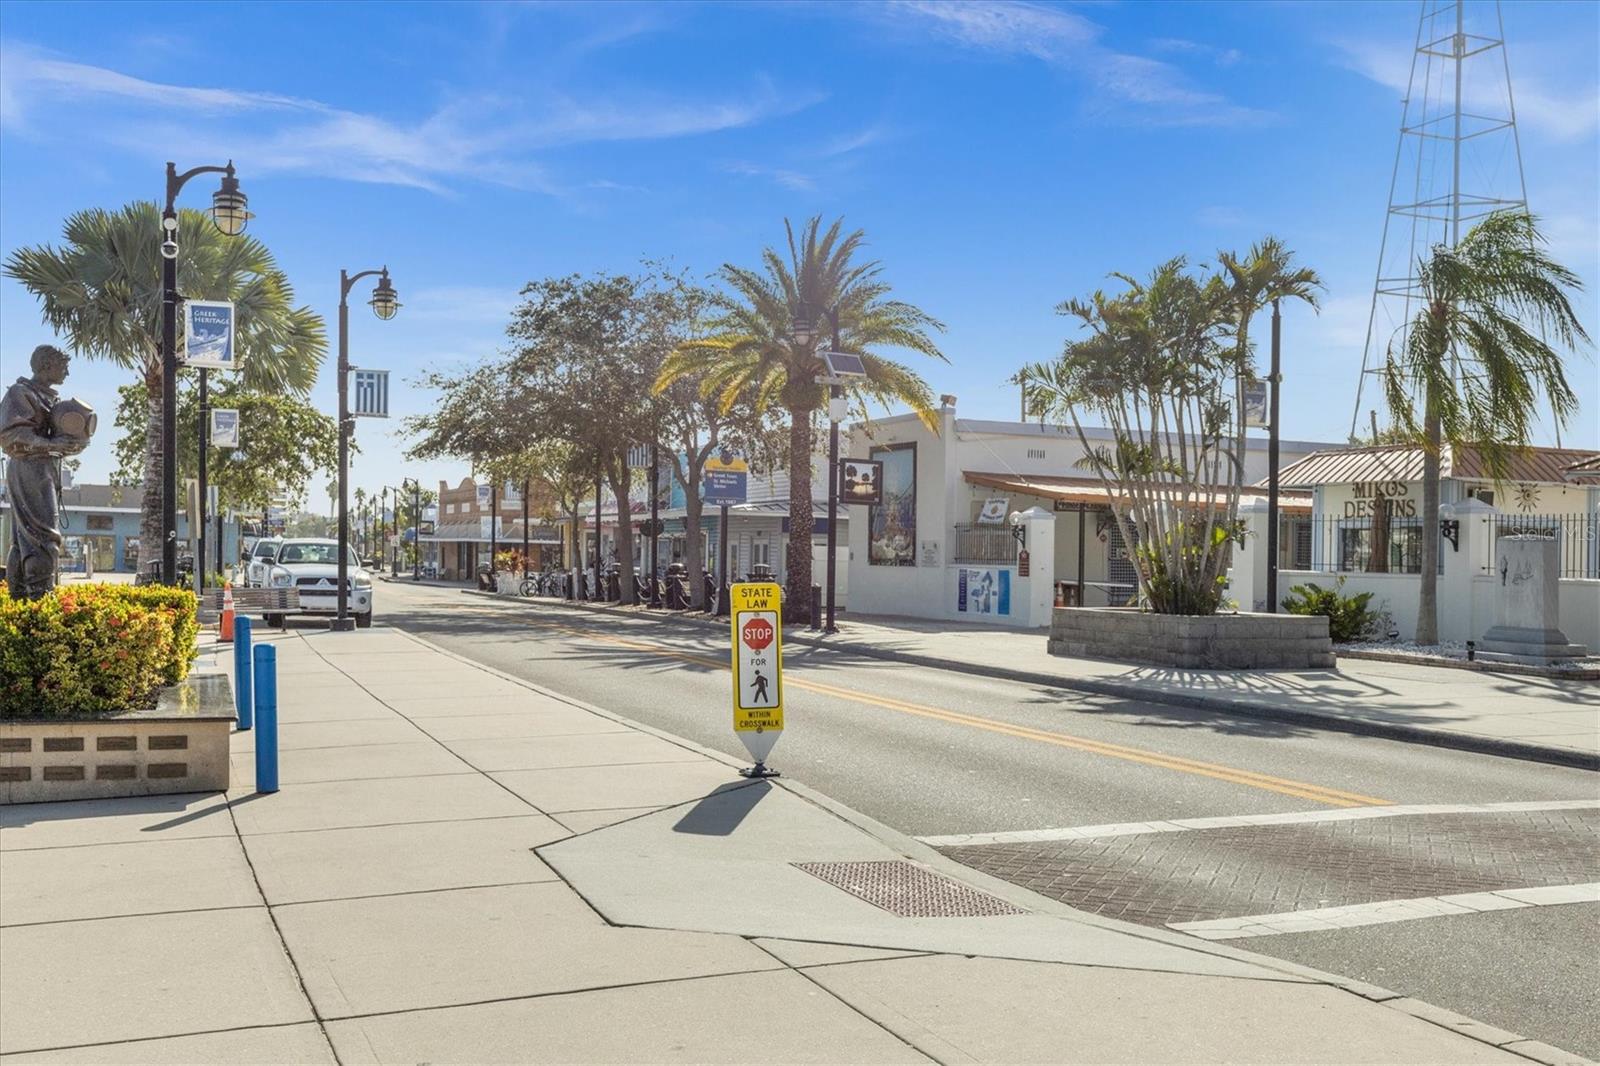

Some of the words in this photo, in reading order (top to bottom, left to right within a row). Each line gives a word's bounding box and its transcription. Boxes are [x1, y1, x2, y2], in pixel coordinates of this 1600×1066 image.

[195, 317, 230, 325] HERITAGE
[1354, 481, 1408, 498] MIKOS
[1344, 499, 1416, 518] DESNS
[741, 588, 773, 598] STATE
[746, 599, 768, 609] LAW
[744, 628, 772, 639] STOP
[750, 658, 767, 666] FOR
[739, 719, 780, 728] CROSSWALK
